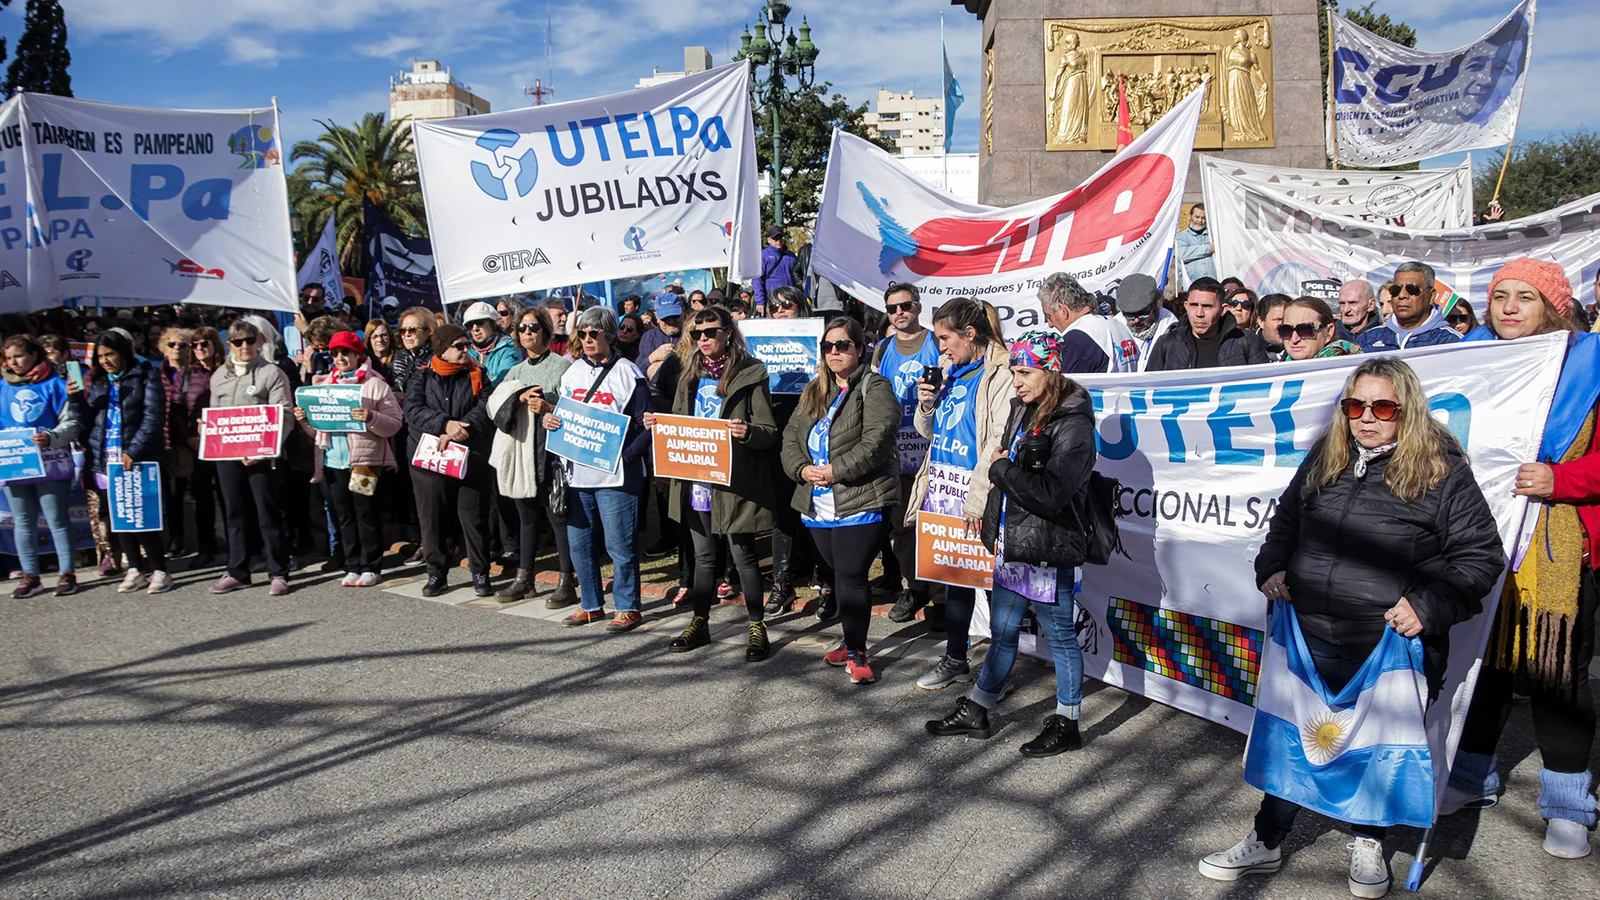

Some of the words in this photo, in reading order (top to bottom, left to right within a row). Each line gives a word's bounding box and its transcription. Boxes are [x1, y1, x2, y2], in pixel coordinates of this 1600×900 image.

[1414, 90, 1460, 112] COMBATIVA
[104, 131, 123, 155] ES
[134, 131, 214, 155] PAMPEANO
[544, 105, 733, 167] UTELPa
[536, 170, 728, 222] JUBILADXS
[482, 246, 552, 274] CTERA
[929, 286, 943, 296] de
[945, 283, 1014, 297] Trabajadores
[1017, 281, 1024, 293] y
[1095, 264, 1107, 275] de
[1305, 282, 1322, 290] POR
[1325, 283, 1333, 291] EL
[1310, 291, 1325, 299] DEL
[756, 344, 774, 353] POR
[774, 343, 803, 353] TODAS
[767, 354, 808, 364] PARTIDAS
[308, 405, 351, 413] COMEDORES
[311, 413, 351, 421] ESCOLARES
[217, 417, 229, 426] EN
[230, 414, 269, 425] DEFENSA
[557, 408, 573, 419] POR
[573, 413, 620, 436] PARITARIA
[206, 427, 217, 435] DE
[230, 422, 279, 433] JUBILACIÓN
[563, 422, 606, 443] NACIONAL
[656, 424, 677, 437] POR
[678, 426, 727, 441] URGENTE
[222, 434, 262, 444] DOCENTE
[563, 432, 602, 453] DOCENTE
[666, 438, 718, 454] AUMENTO
[667, 451, 719, 467] SALARIAL
[949, 472, 960, 483] DE
[114, 476, 124, 505] TODAS
[123, 471, 134, 510] PARTIDAS
[117, 506, 125, 518] POR
[126, 511, 134, 523] LAS
[135, 508, 144, 528] PARA
[922, 522, 946, 537] POR
[933, 553, 994, 573] SALARIAL
